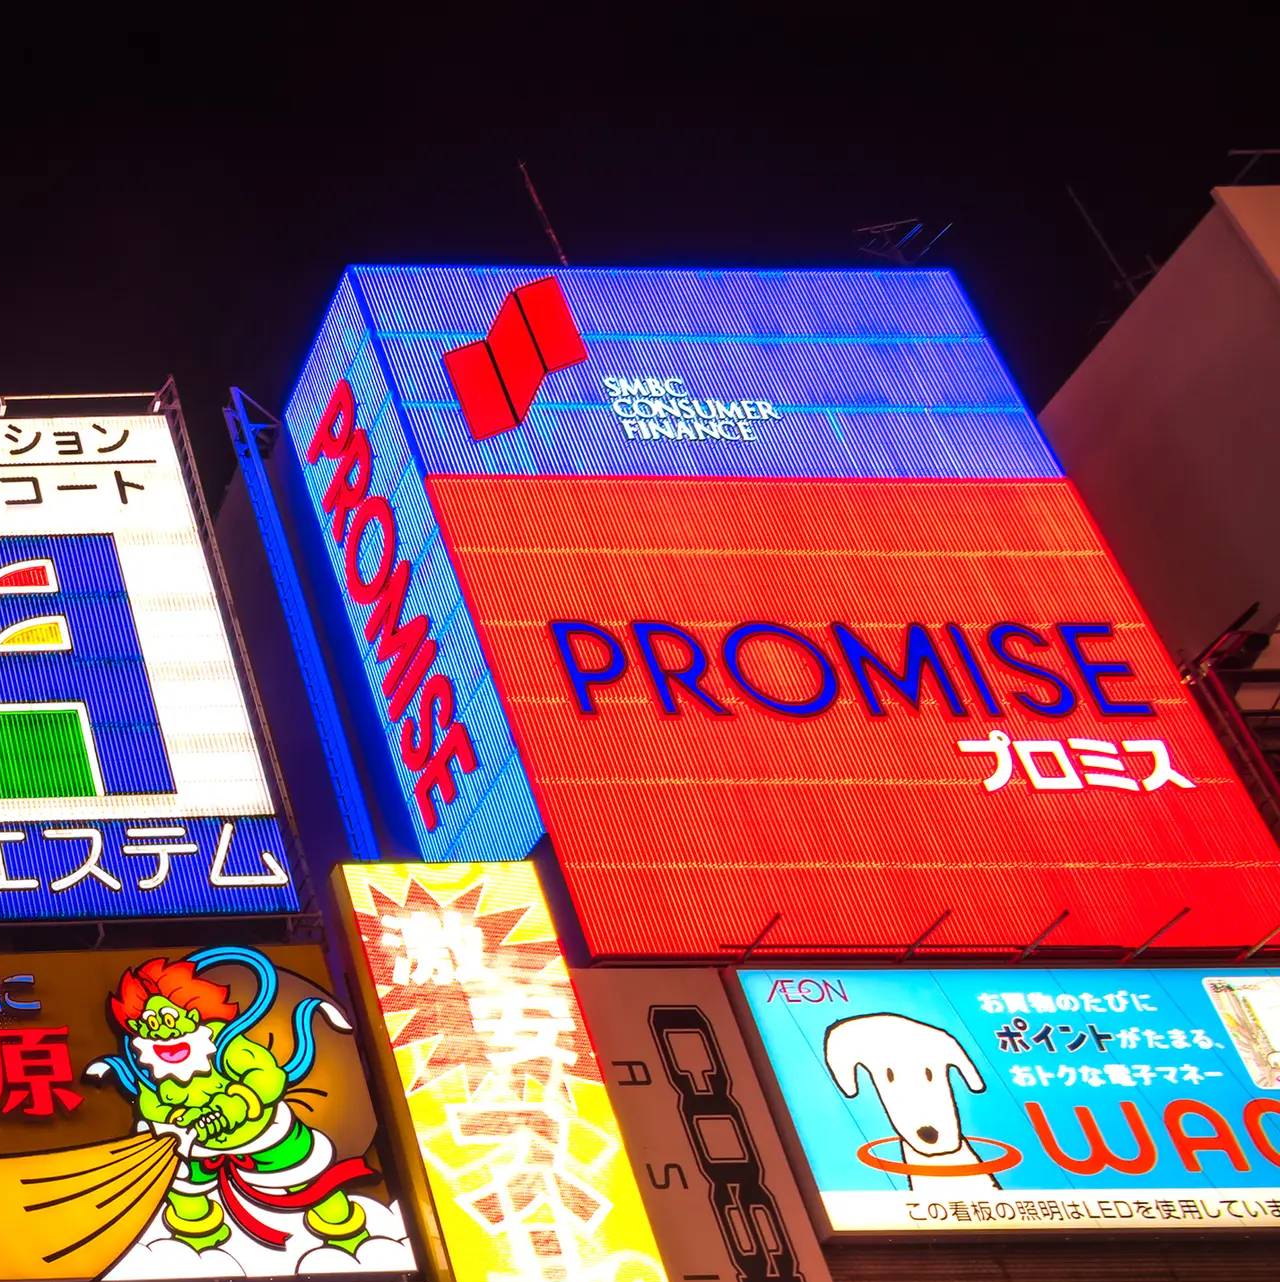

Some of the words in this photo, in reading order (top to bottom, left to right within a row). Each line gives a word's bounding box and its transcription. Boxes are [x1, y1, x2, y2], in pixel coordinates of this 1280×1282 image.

[603, 376, 689, 400] SMBC
[612, 398, 782, 421] CONSUMER
[623, 420, 758, 443] FINANCE
[308, 379, 478, 831] PROMISE
[548, 619, 1158, 718] PROMISE
[957, 729, 1197, 792] プロミス
[977, 991, 1158, 1013] お買物のたびに
[1009, 1064, 1223, 1087] おトクな電子マネー
